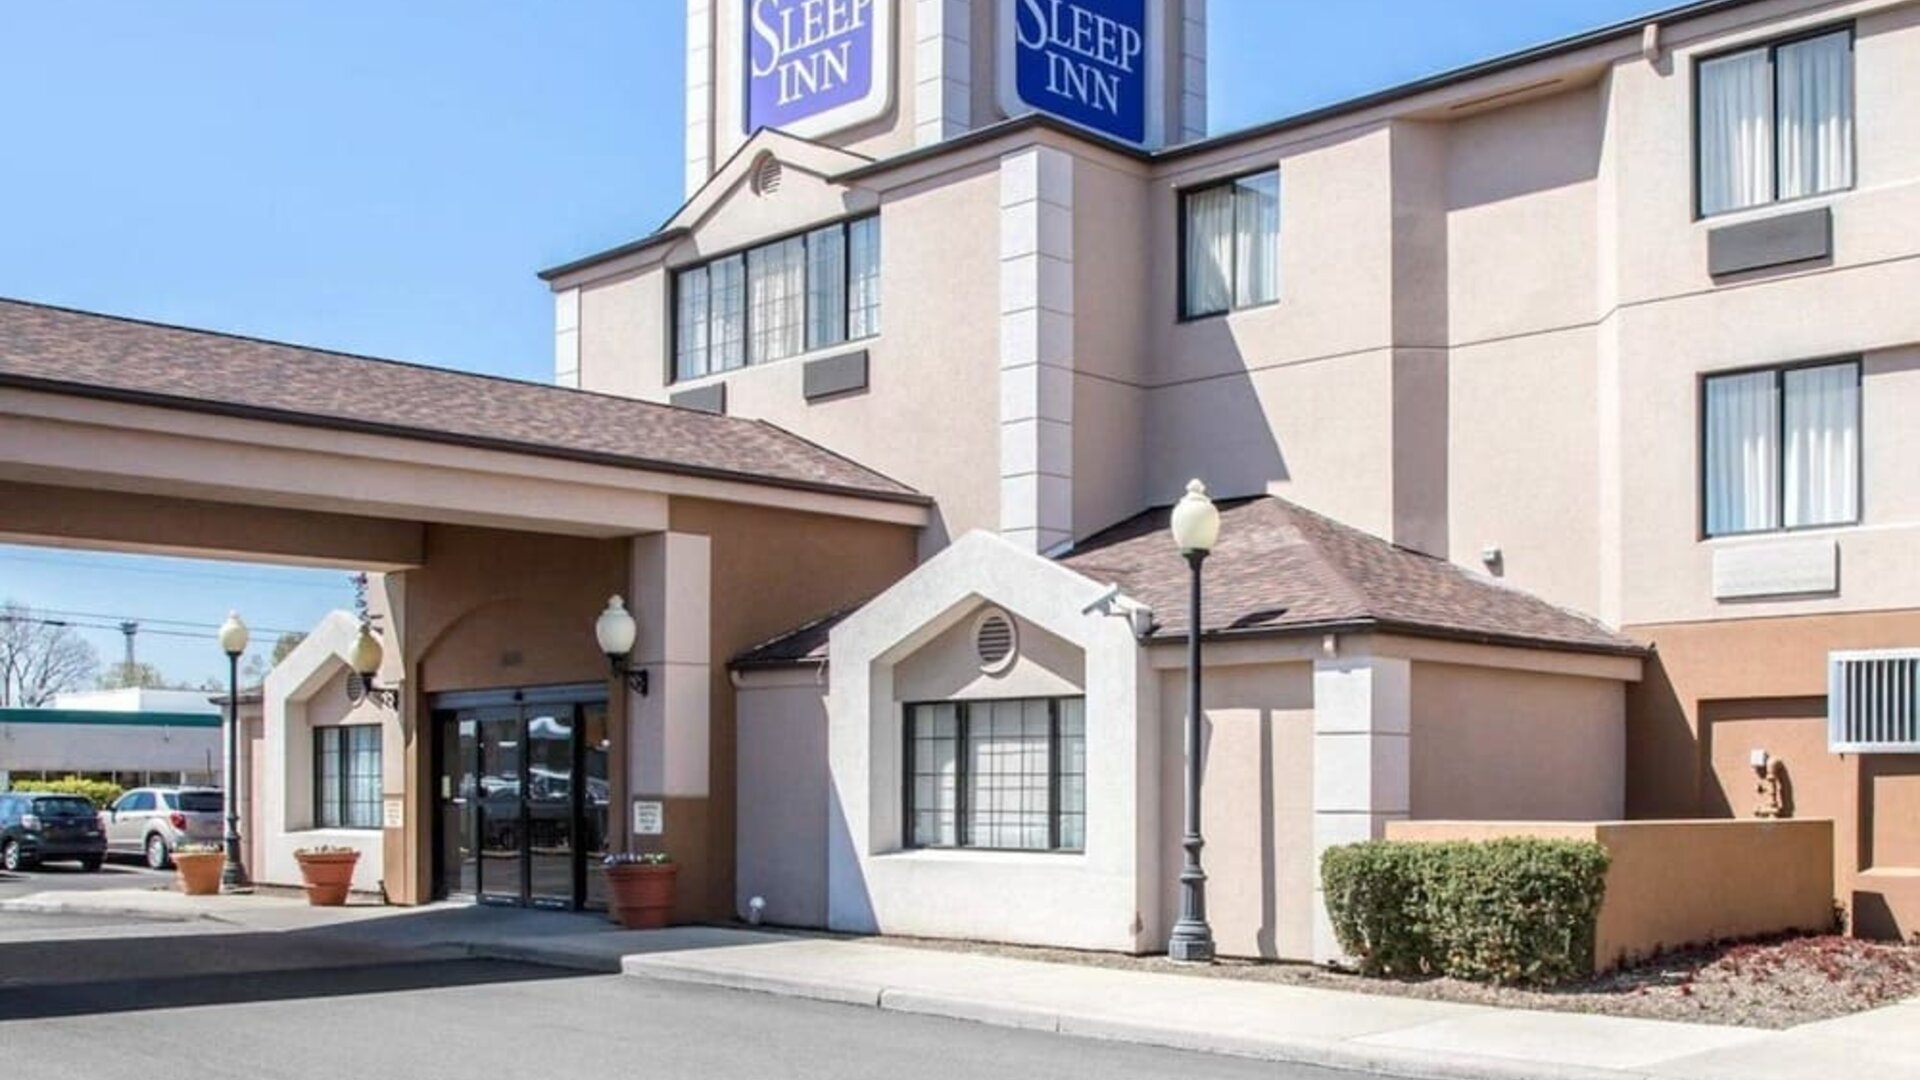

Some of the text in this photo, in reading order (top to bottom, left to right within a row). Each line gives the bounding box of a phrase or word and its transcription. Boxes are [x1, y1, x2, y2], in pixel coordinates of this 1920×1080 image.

[752, 0, 871, 76] SLEEP
[777, 41, 852, 106] INN
[1044, 49, 1121, 115] INN
